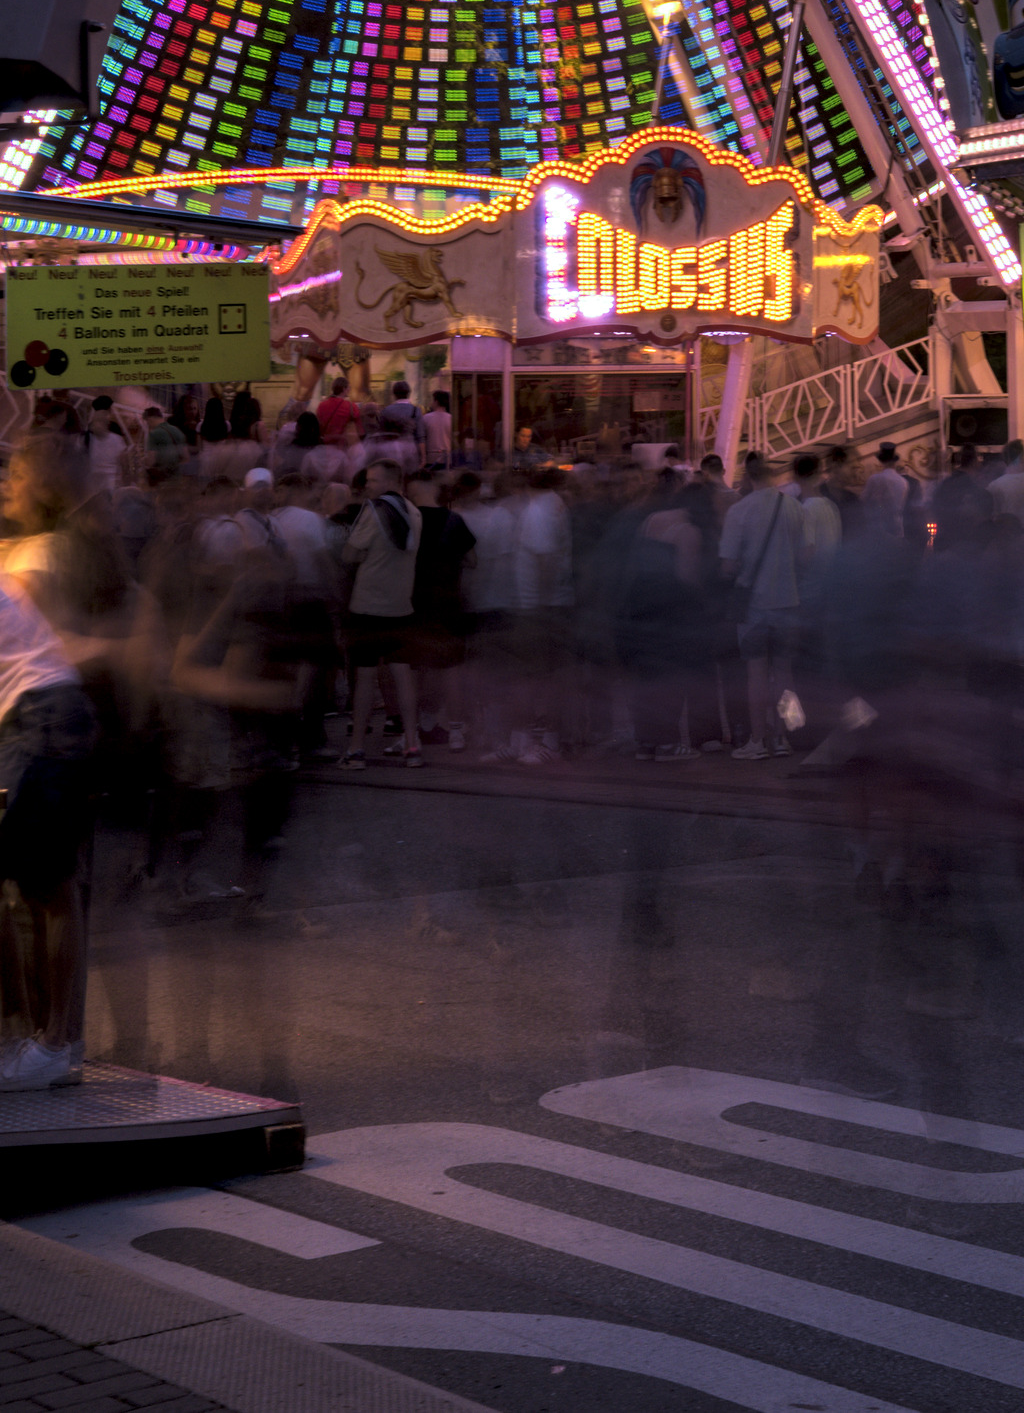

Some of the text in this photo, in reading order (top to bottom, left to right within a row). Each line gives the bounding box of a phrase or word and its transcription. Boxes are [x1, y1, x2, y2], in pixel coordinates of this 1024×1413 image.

[544, 185, 794, 322] COLOSSUS
[48, 268, 79, 280] Neu!
[88, 267, 118, 279] Neu!
[128, 267, 156, 279] Neu!
[166, 266, 195, 278] Neu!
[204, 266, 233, 277] Neu!
[94, 286, 190, 298] Das neue Spiel!
[33, 304, 209, 320] Treffen Sie mit 4 Pfeilen
[58, 324, 209, 339] 4 Ballons im Quadrat
[82, 347, 98, 355] und
[101, 346, 115, 354] Sie
[118, 346, 143, 354] haben
[86, 355, 201, 367] Ansonsten erwartet Sie ein
[112, 370, 176, 382] Trostpreis.
